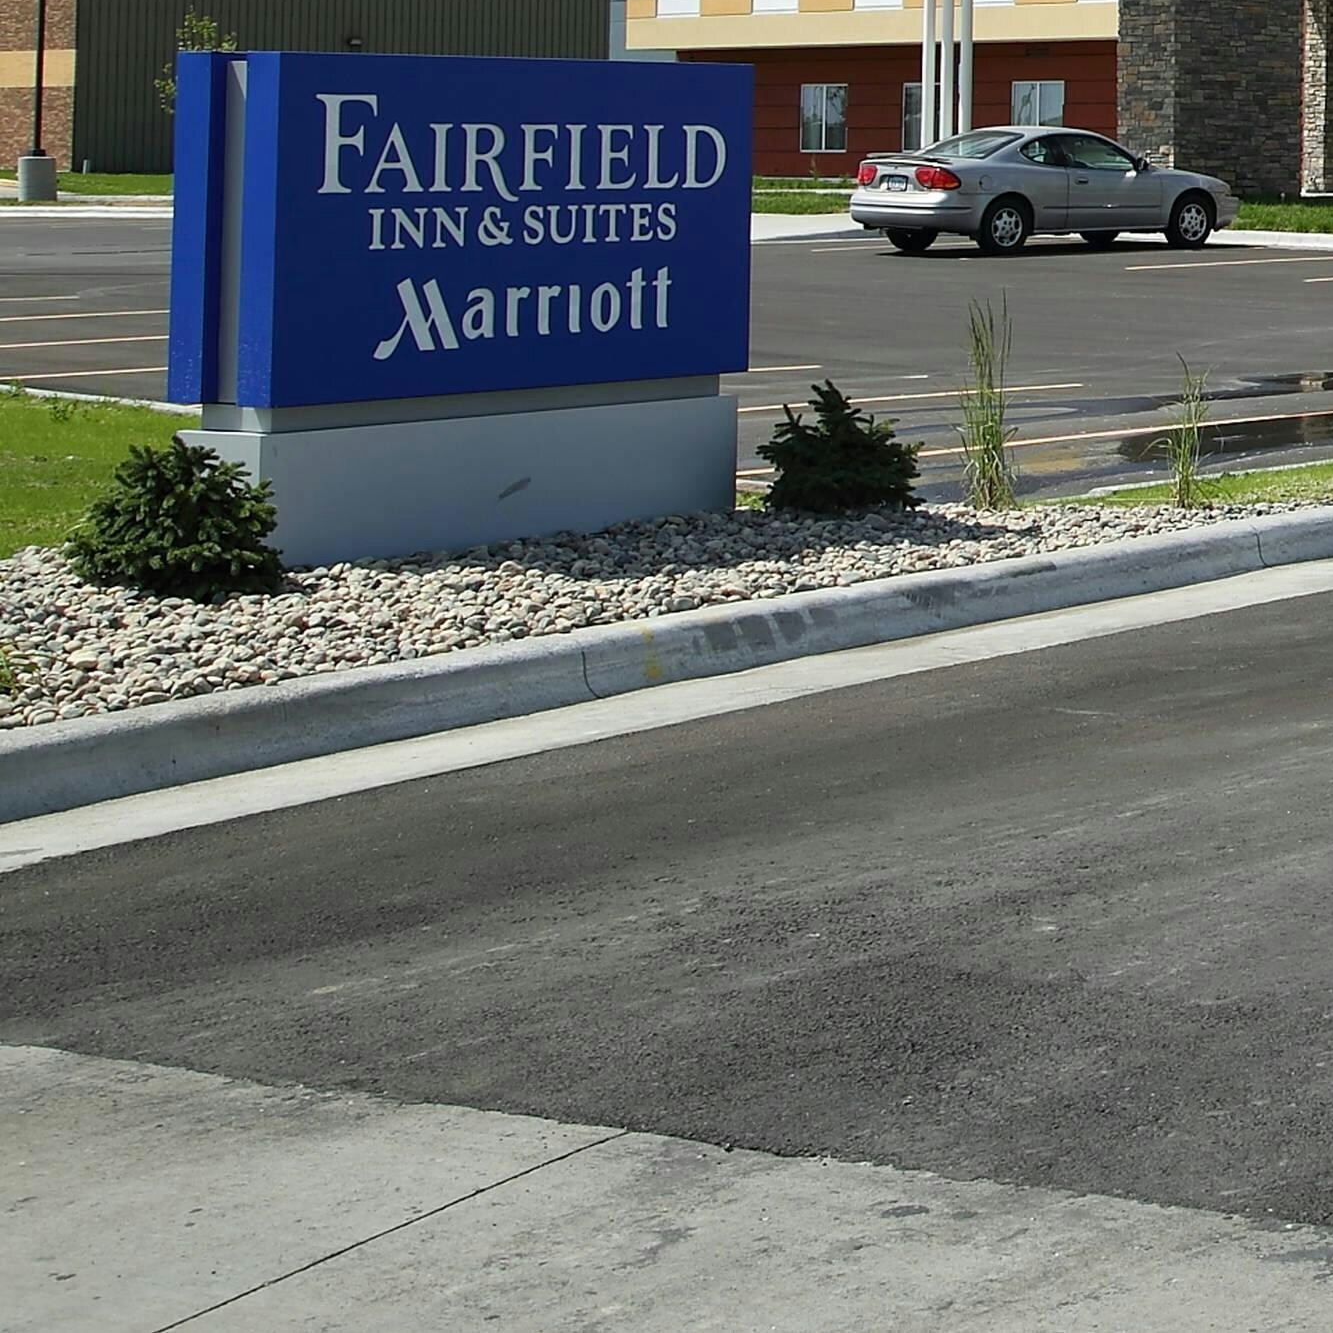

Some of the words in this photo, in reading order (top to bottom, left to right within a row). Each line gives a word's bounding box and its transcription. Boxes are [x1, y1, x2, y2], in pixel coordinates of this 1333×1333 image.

[316, 93, 728, 203] FAIRFIELD
[522, 202, 678, 246] SUITES
[373, 265, 673, 361] Marriott
